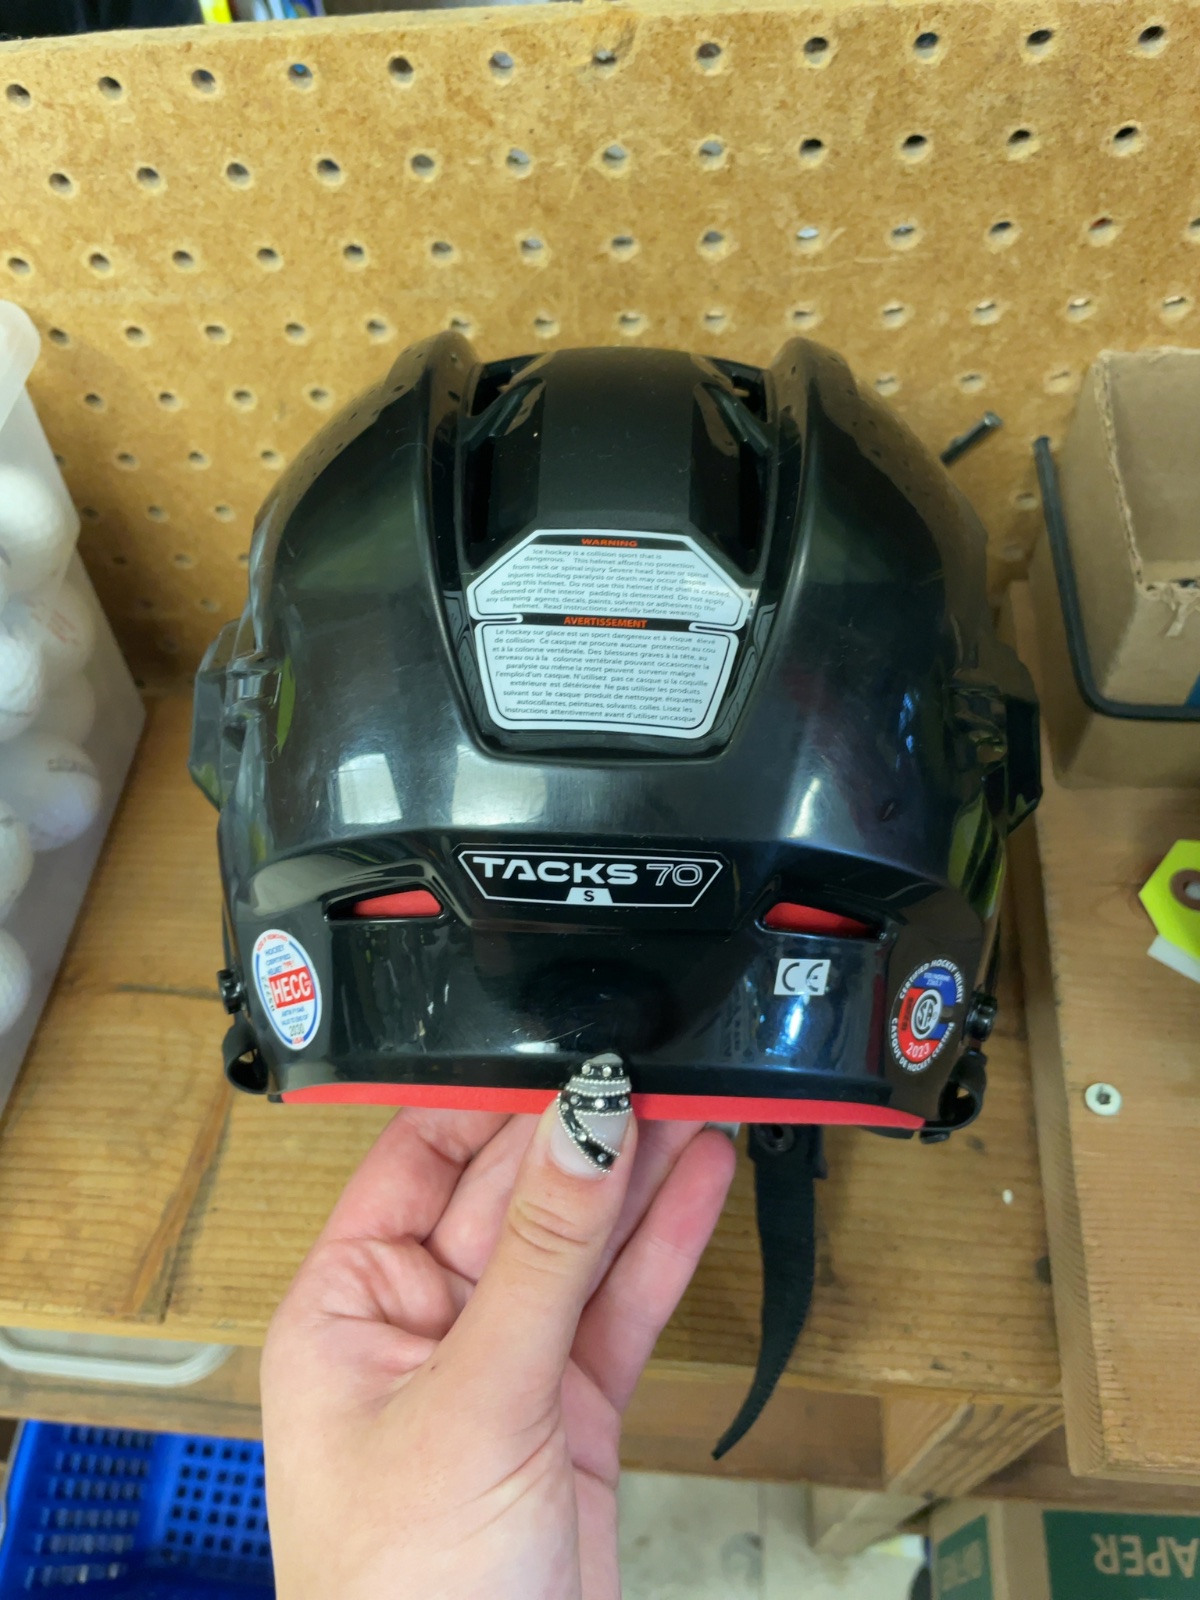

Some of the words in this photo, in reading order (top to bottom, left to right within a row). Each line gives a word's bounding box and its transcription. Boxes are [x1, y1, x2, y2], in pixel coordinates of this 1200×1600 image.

[581, 538, 638, 548] WARNING
[563, 616, 648, 628] AVERTISSEMENT
[473, 856, 638, 885] TACKS
[646, 863, 703, 886] 70
[583, 890, 595, 902] S
[270, 972, 312, 1004] HECC
[906, 1042, 930, 1058] 2023
